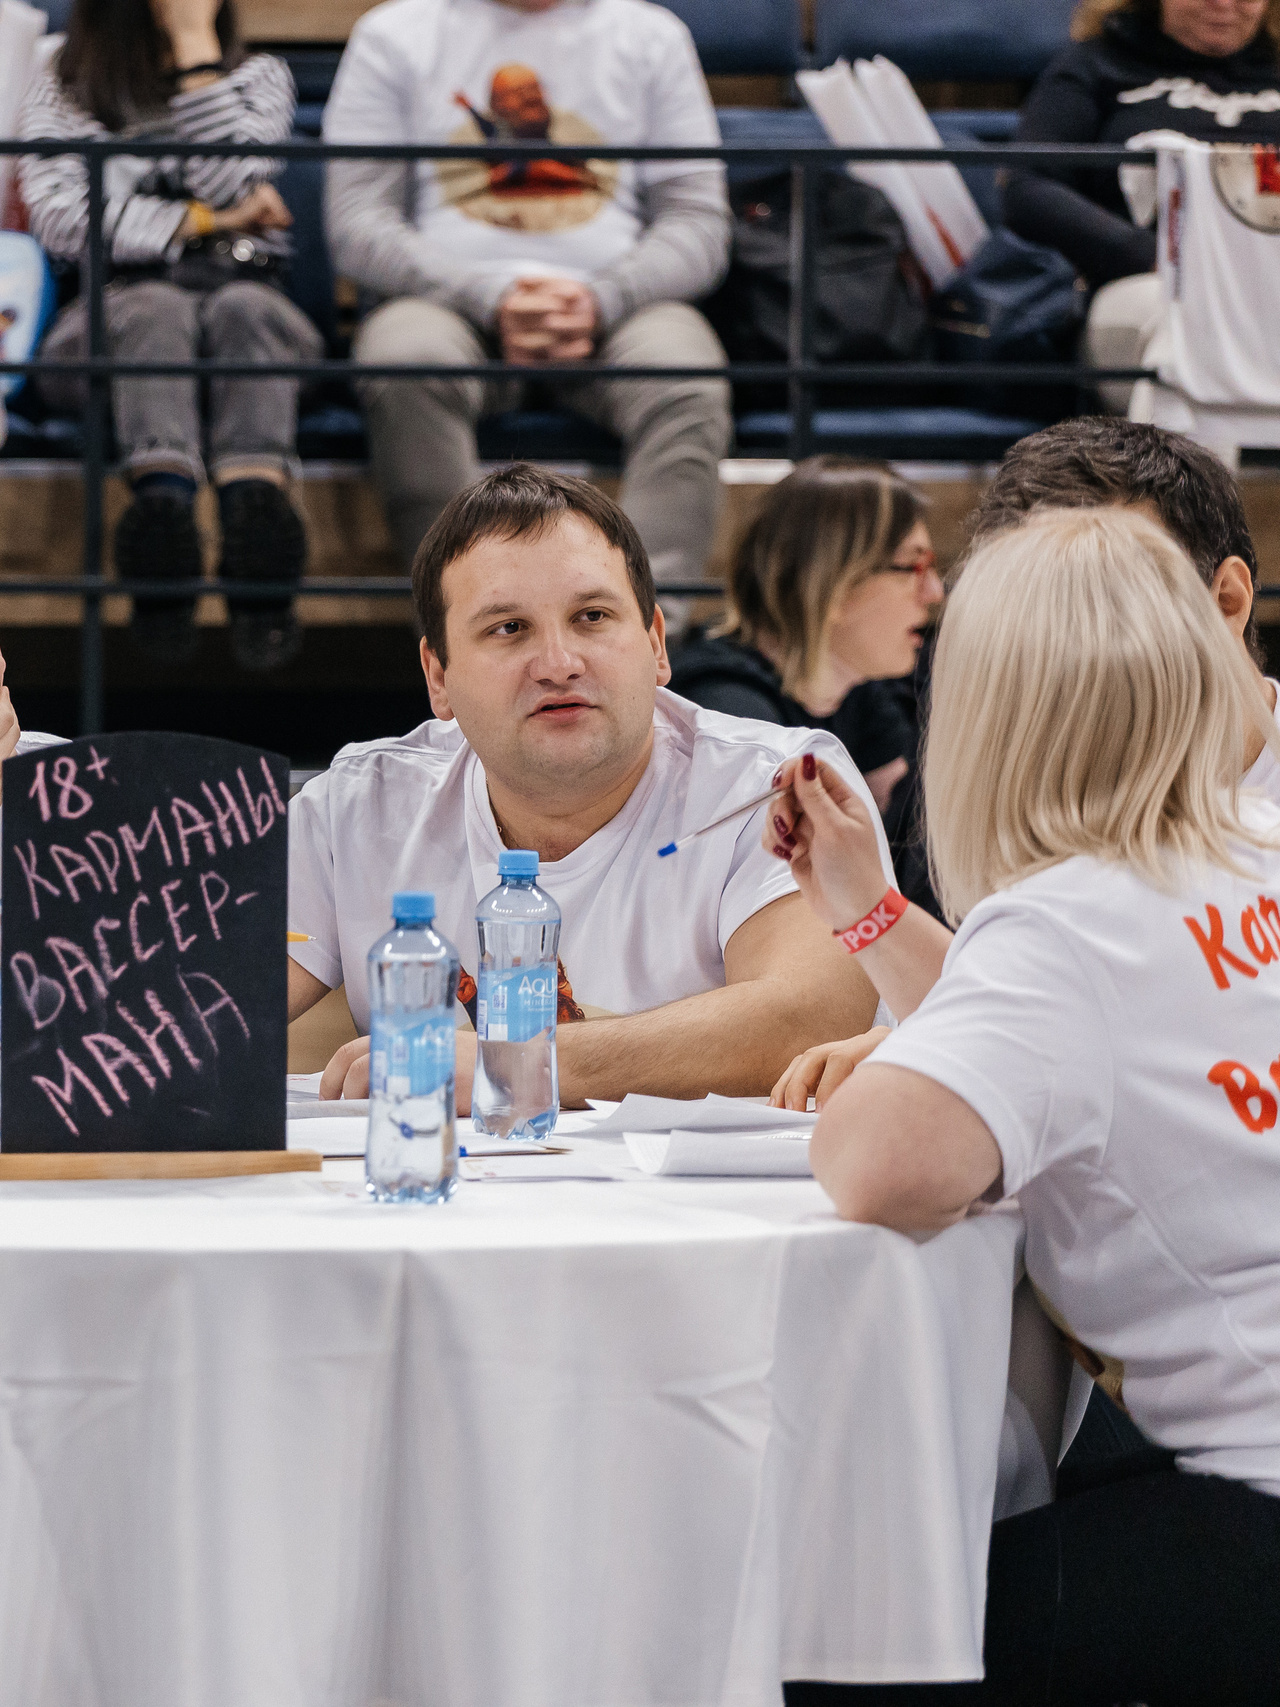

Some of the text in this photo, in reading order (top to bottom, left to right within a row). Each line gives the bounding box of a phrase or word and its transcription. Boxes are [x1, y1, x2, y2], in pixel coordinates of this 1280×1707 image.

[14, 757, 288, 919] КАРМАНЫ
[28, 746, 110, 822] 18+
[11, 871, 260, 1030] ВАССЕР-
[518, 976, 556, 998] AQU
[32, 964, 252, 1137] МАНА
